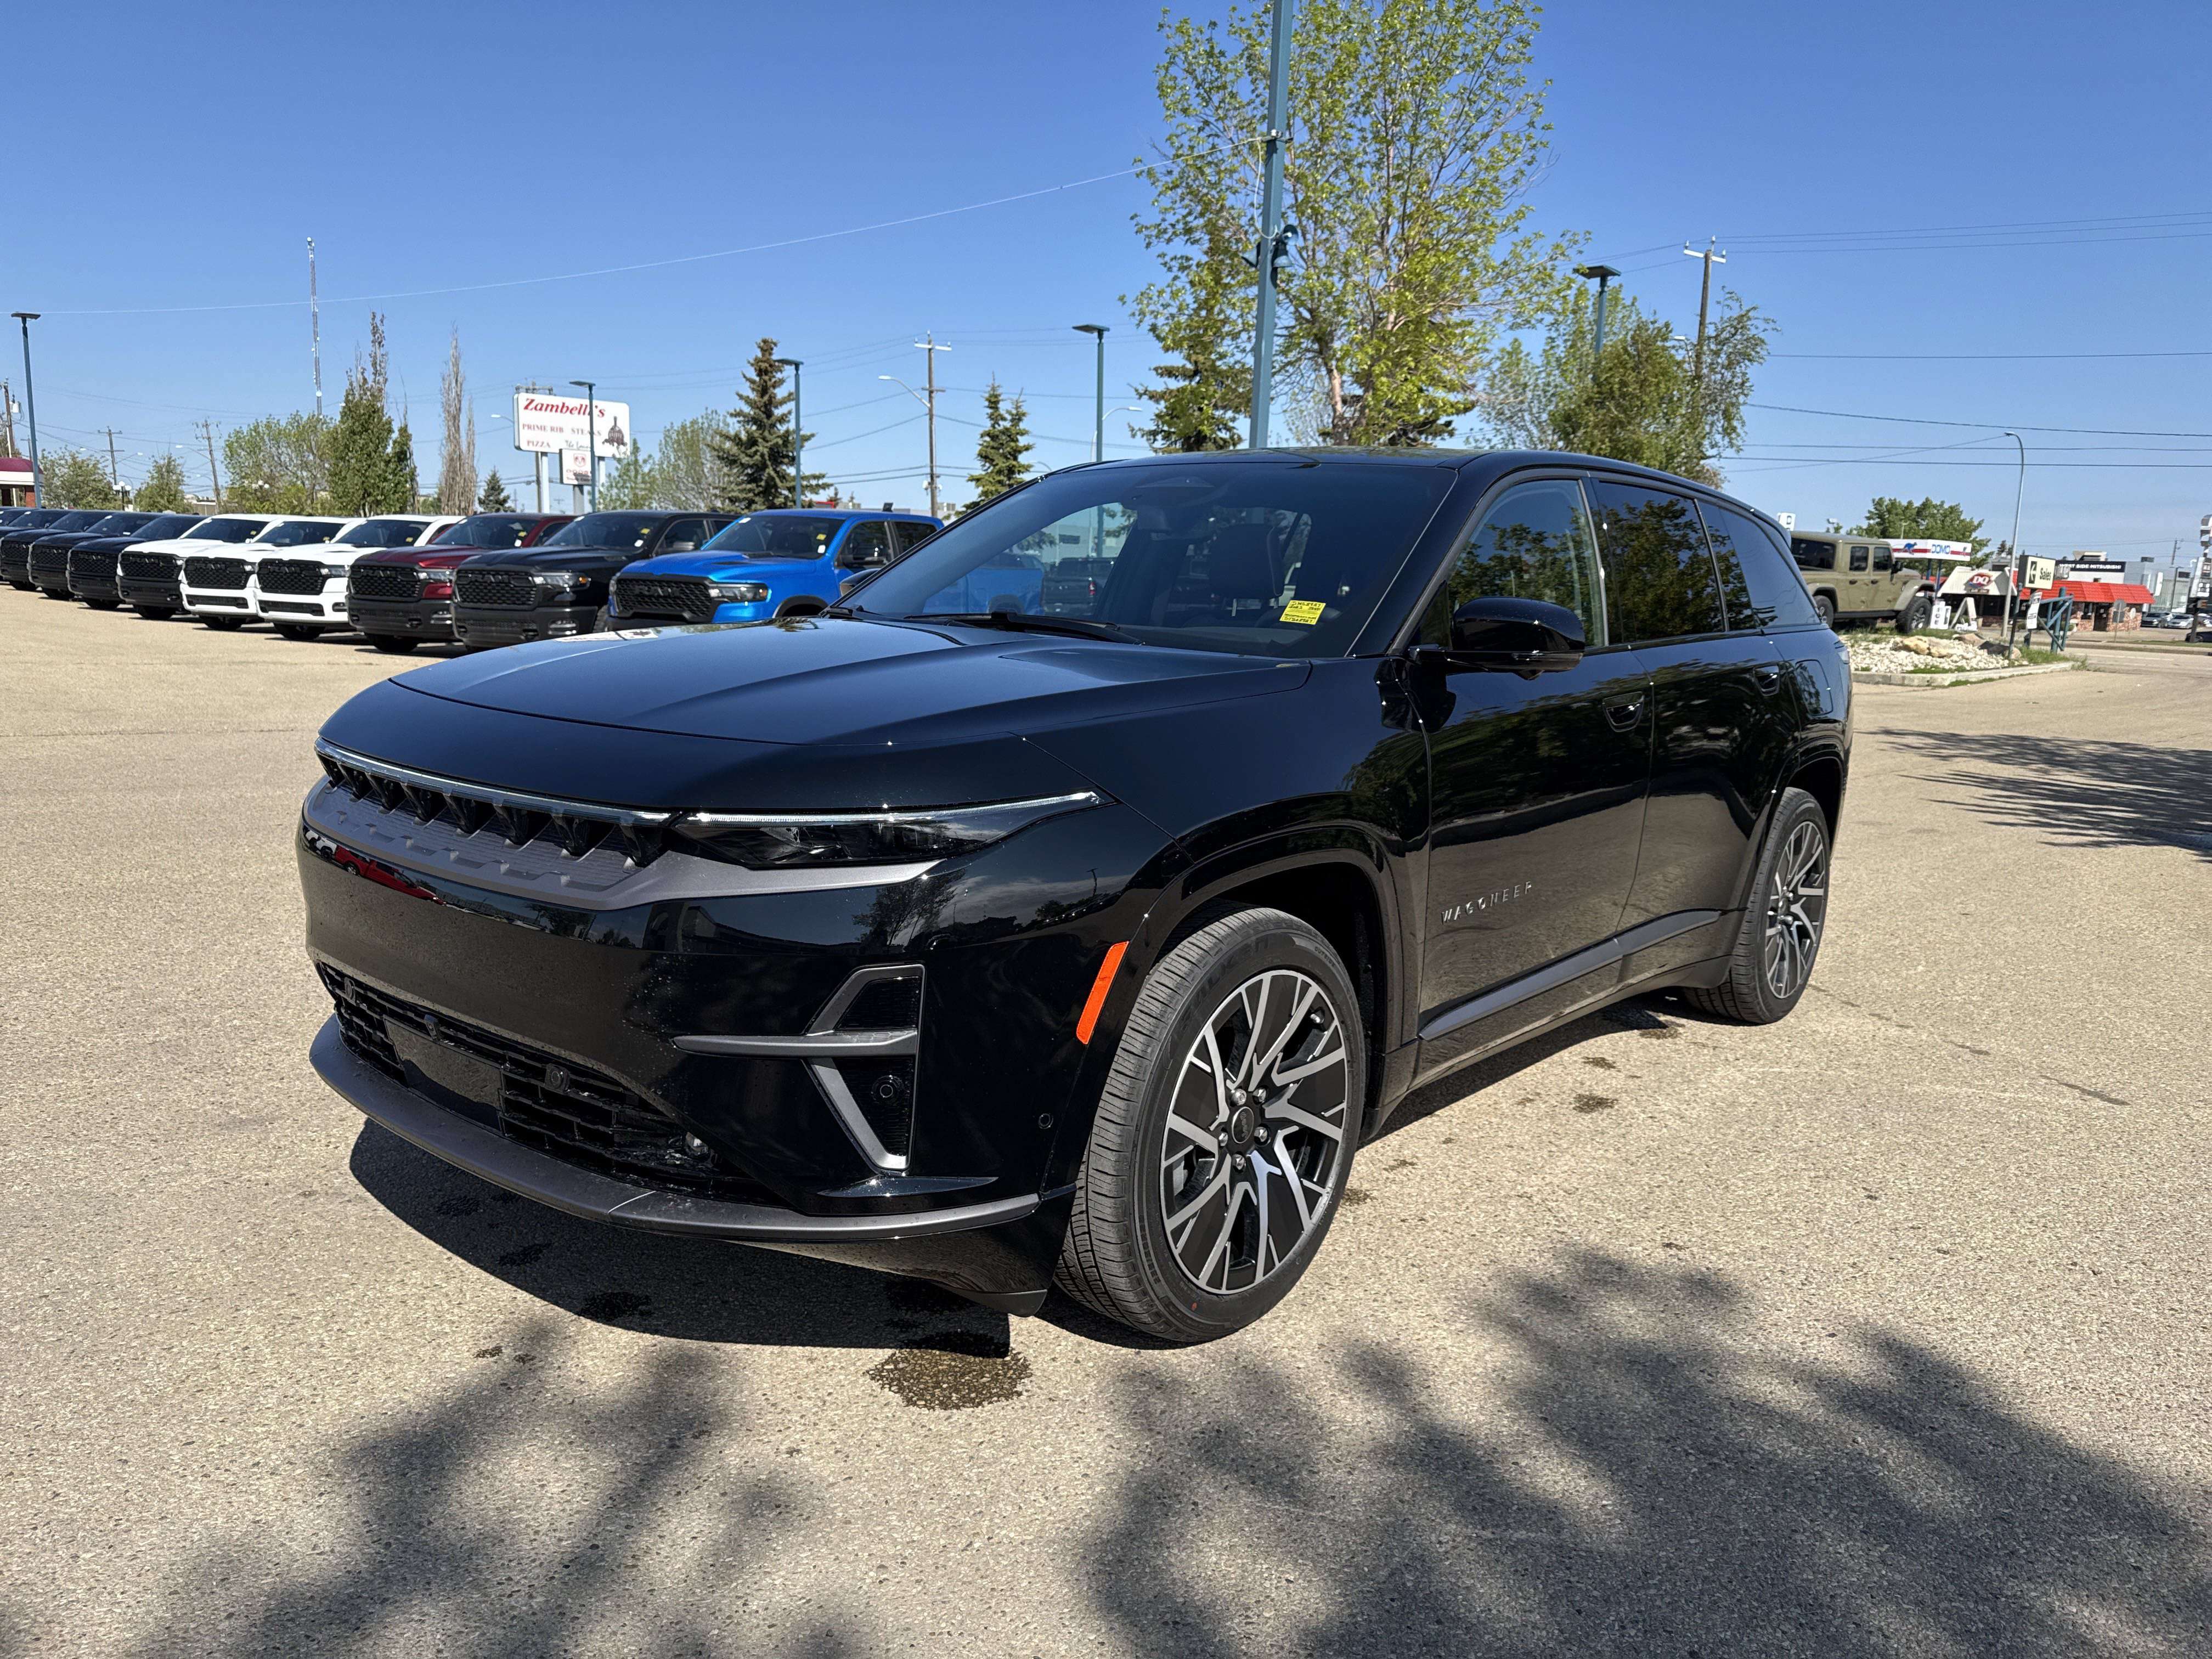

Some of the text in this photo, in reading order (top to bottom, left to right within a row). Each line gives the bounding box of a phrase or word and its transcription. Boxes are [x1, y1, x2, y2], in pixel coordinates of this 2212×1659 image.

[523, 398, 605, 417] Zambell's
[522, 424, 548, 432] PRIME
[527, 440, 551, 448] PIZZA
[1932, 544, 1950, 555] DOMO
[2040, 567, 2051, 581] Sales
[1973, 576, 1989, 585] DQ
[1441, 881, 1532, 924] WAGONEER
